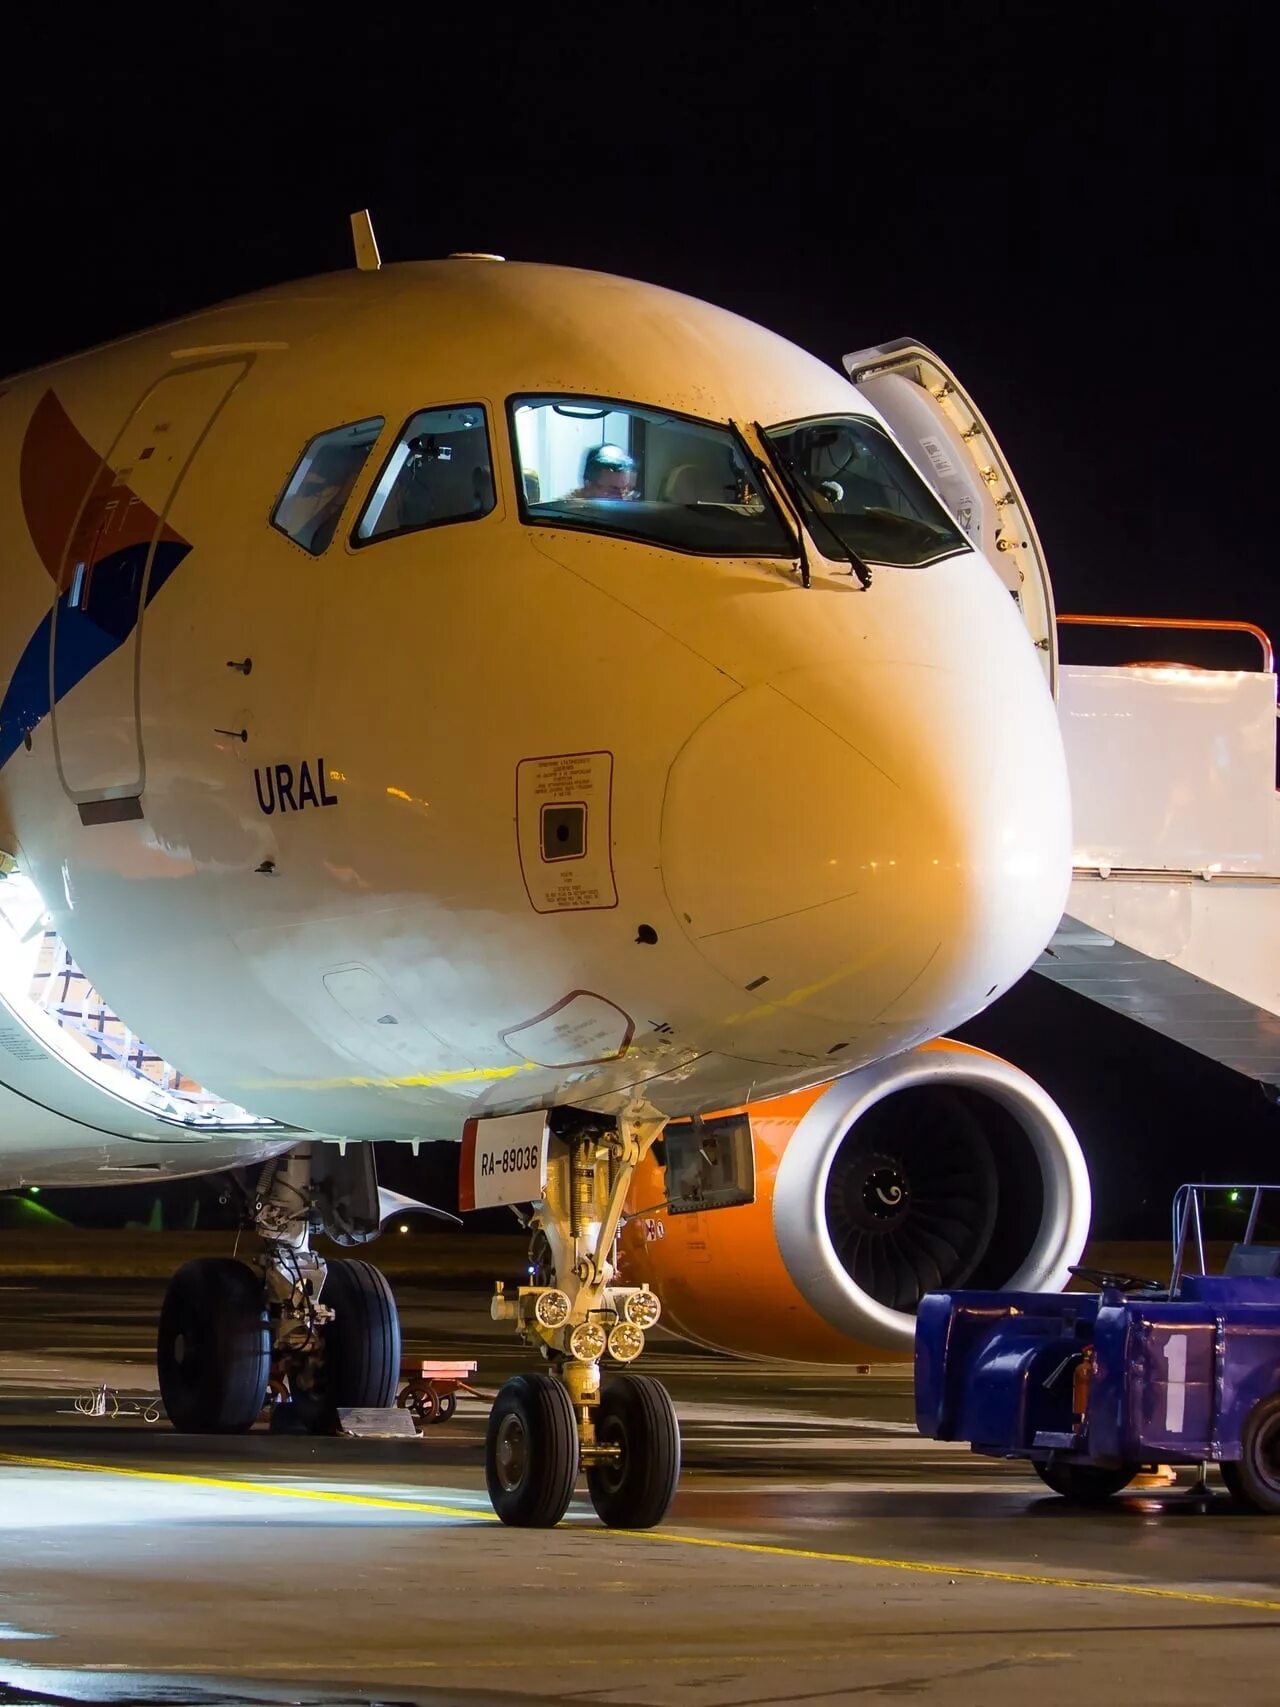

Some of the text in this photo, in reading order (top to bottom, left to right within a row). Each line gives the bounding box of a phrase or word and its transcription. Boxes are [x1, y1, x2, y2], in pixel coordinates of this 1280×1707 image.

[254, 758, 338, 815] URAL
[481, 1145, 538, 1176] RA-89036
[1163, 1334, 1188, 1432] 1
